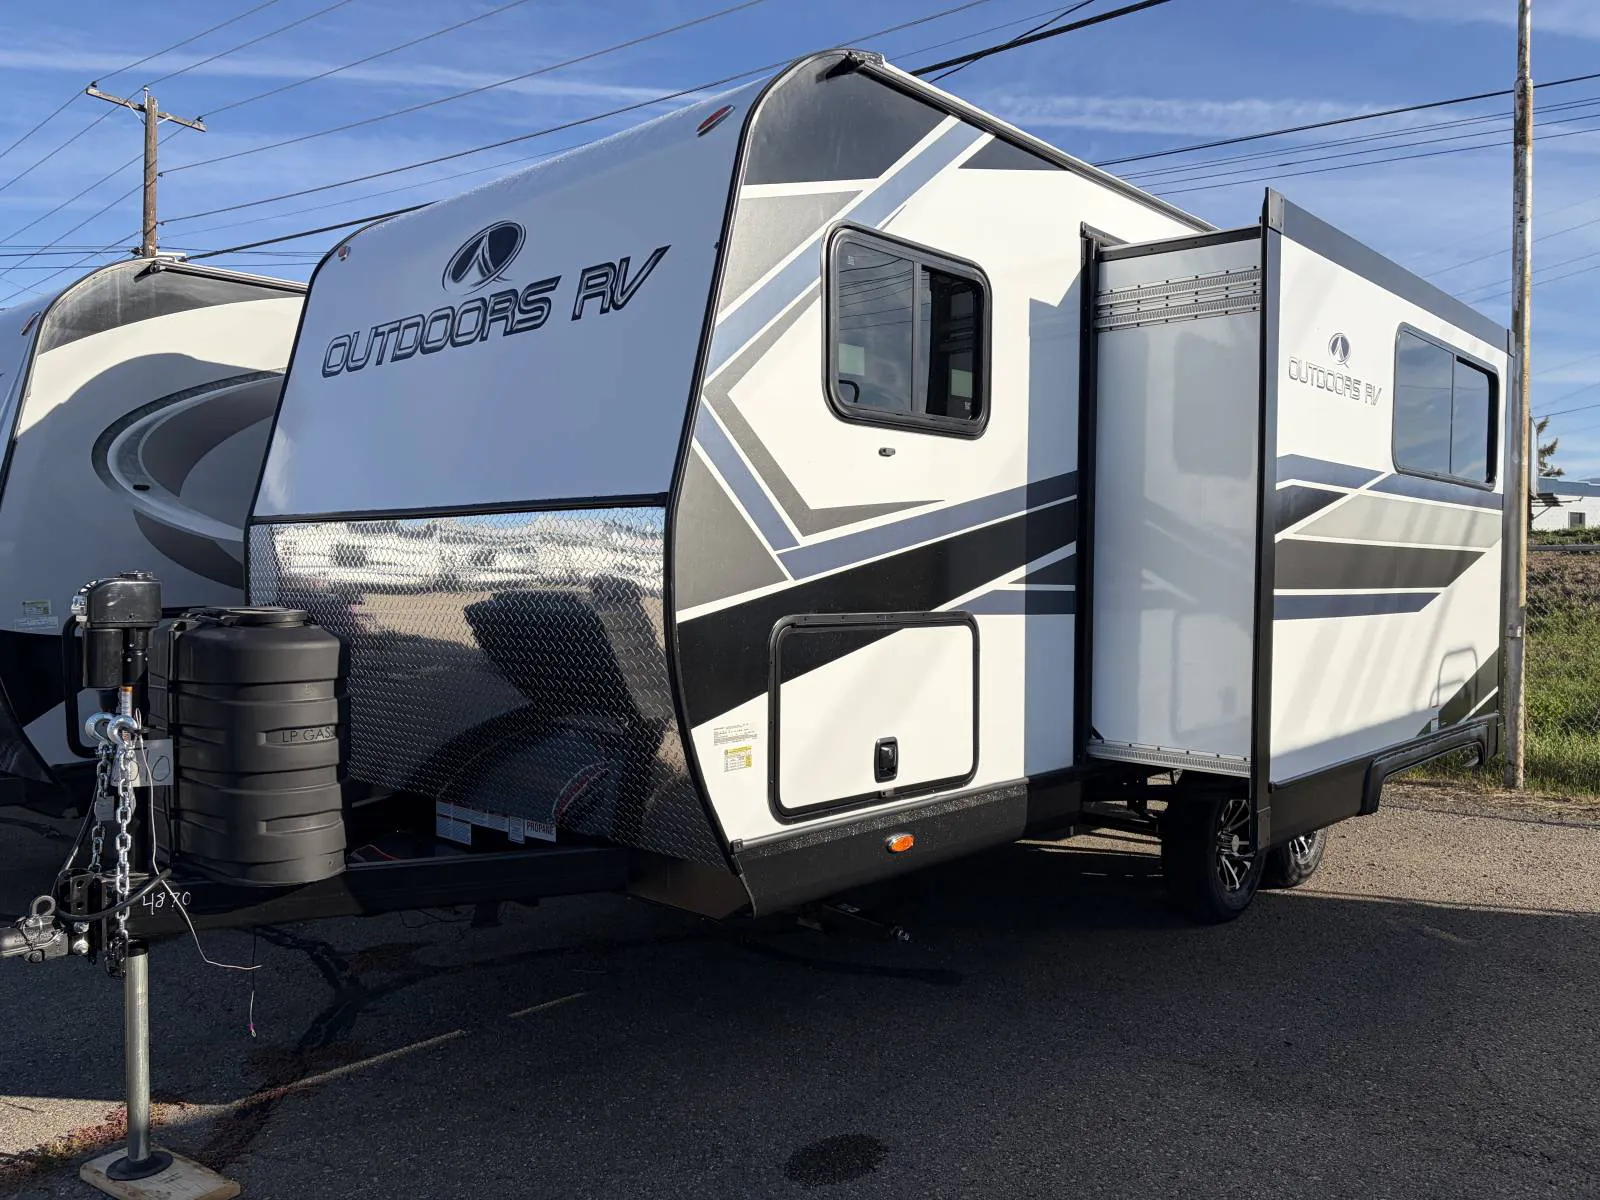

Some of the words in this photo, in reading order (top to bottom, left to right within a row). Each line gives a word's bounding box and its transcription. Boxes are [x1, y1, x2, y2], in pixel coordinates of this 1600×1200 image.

[322, 275, 561, 378] OUTDOORS
[571, 244, 671, 321] RV
[1288, 356, 1362, 401] OUTDOORS
[1365, 382, 1382, 406] RV
[282, 730, 298, 743] LP
[303, 726, 331, 741] GAS
[526, 821, 555, 836] PROPANE
[142, 891, 191, 916] 4870
